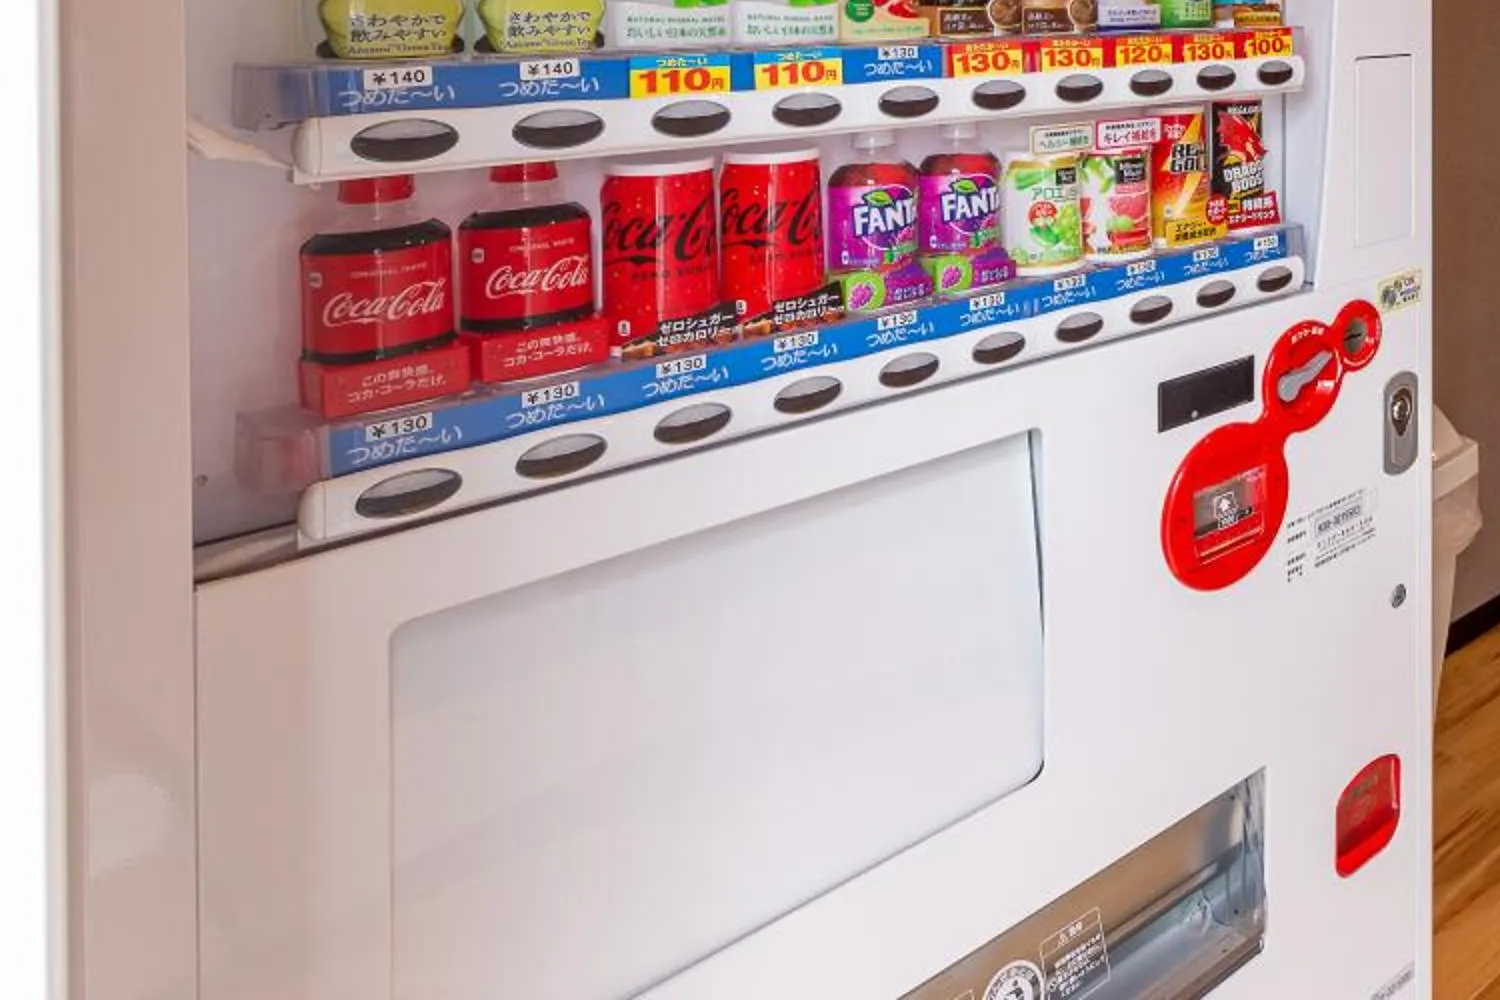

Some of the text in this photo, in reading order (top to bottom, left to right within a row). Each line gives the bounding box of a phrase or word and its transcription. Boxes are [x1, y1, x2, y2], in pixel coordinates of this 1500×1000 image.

[372, 71, 425, 86] ¥140
[527, 61, 573, 75] ¥140
[639, 67, 725, 93] 110円
[761, 61, 837, 87] 110円
[485, 255, 590, 299] Coca-Cola
[322, 277, 446, 327] Coca-Cola
[527, 384, 576, 405] ¥130
[372, 415, 428, 439] ¥130
